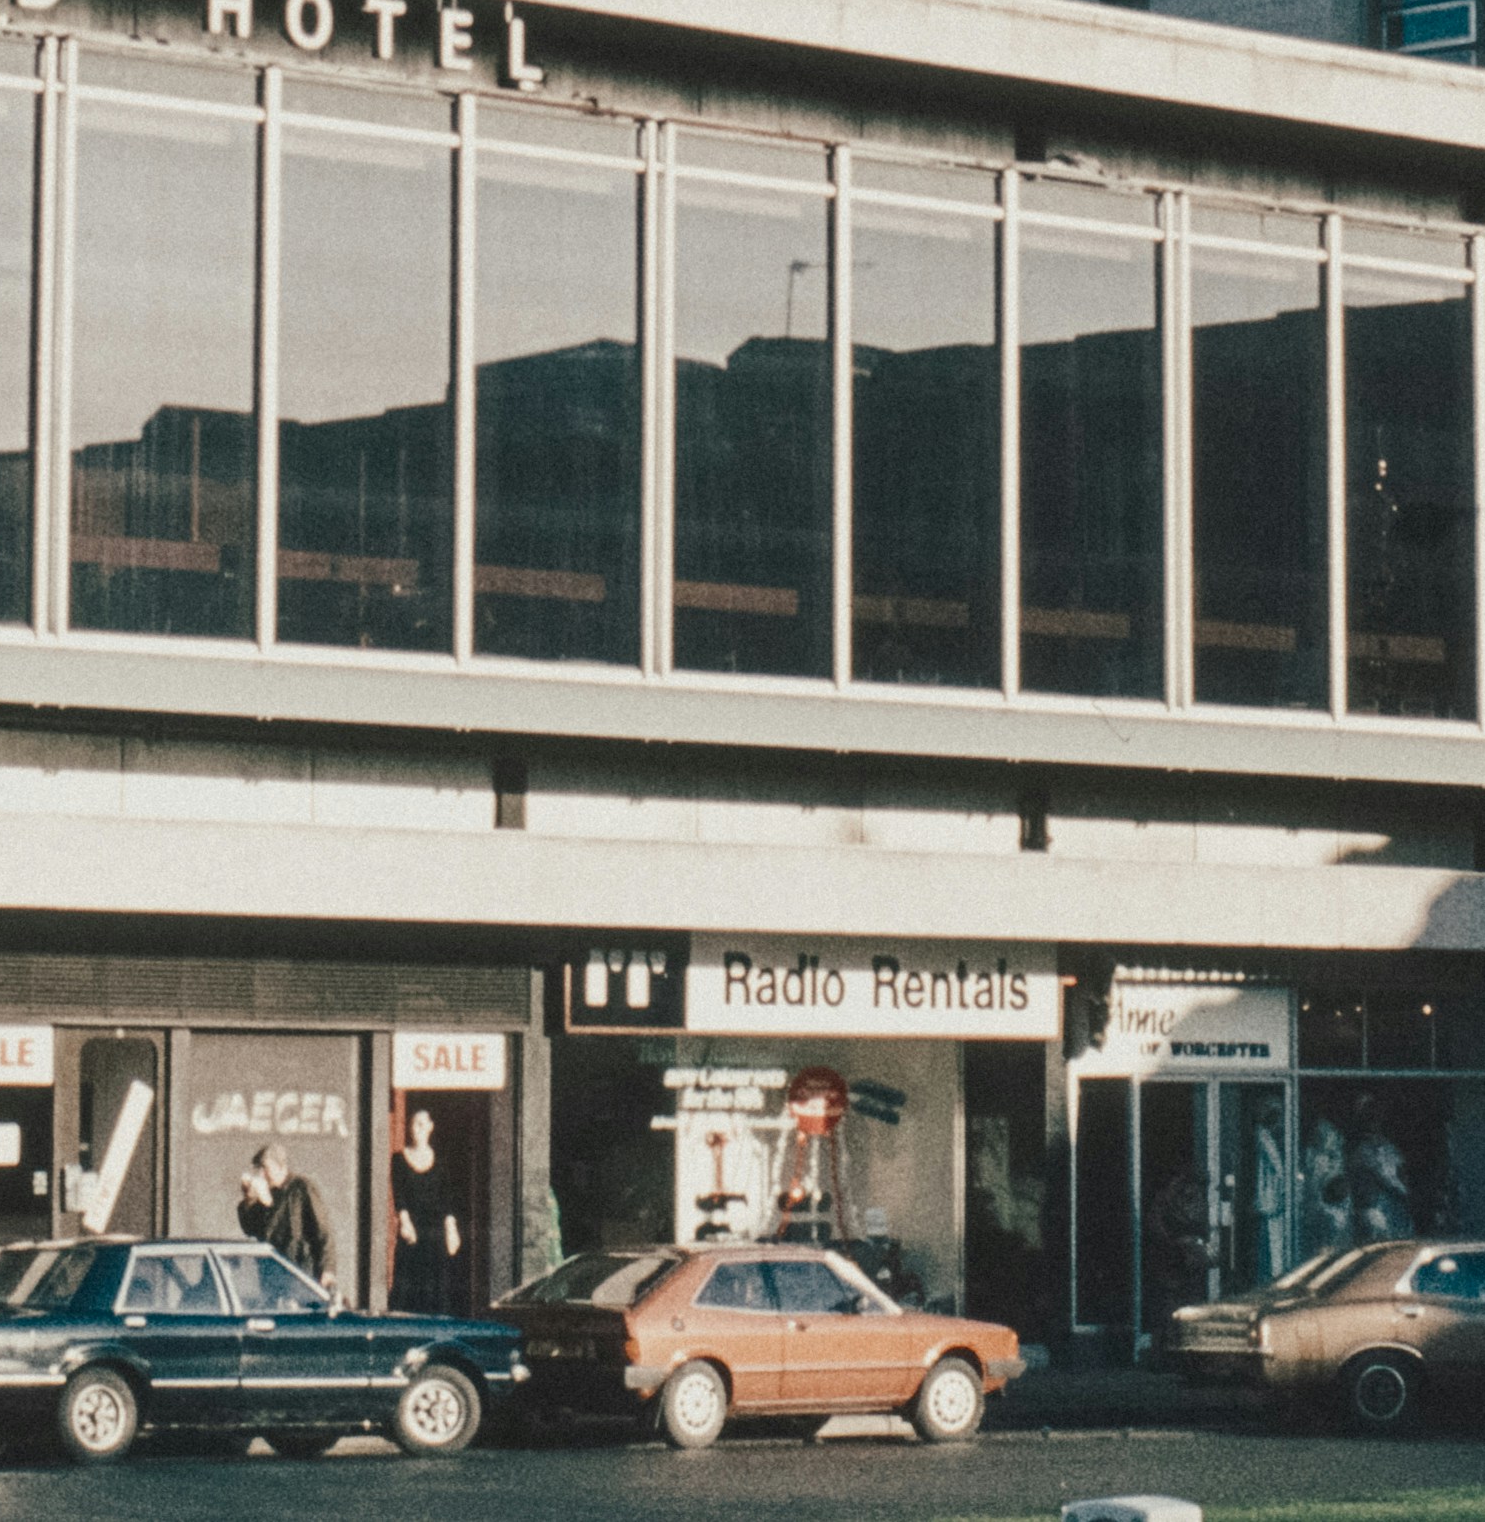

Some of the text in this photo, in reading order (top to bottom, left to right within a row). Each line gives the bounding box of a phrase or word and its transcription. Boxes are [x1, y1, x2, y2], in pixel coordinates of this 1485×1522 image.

[723, 952, 1030, 1011] Radio Rentals
[412, 1042, 488, 1074] SALE
[1169, 1041, 1271, 1059] WORCESTER
[191, 1090, 350, 1137] JAEGER
